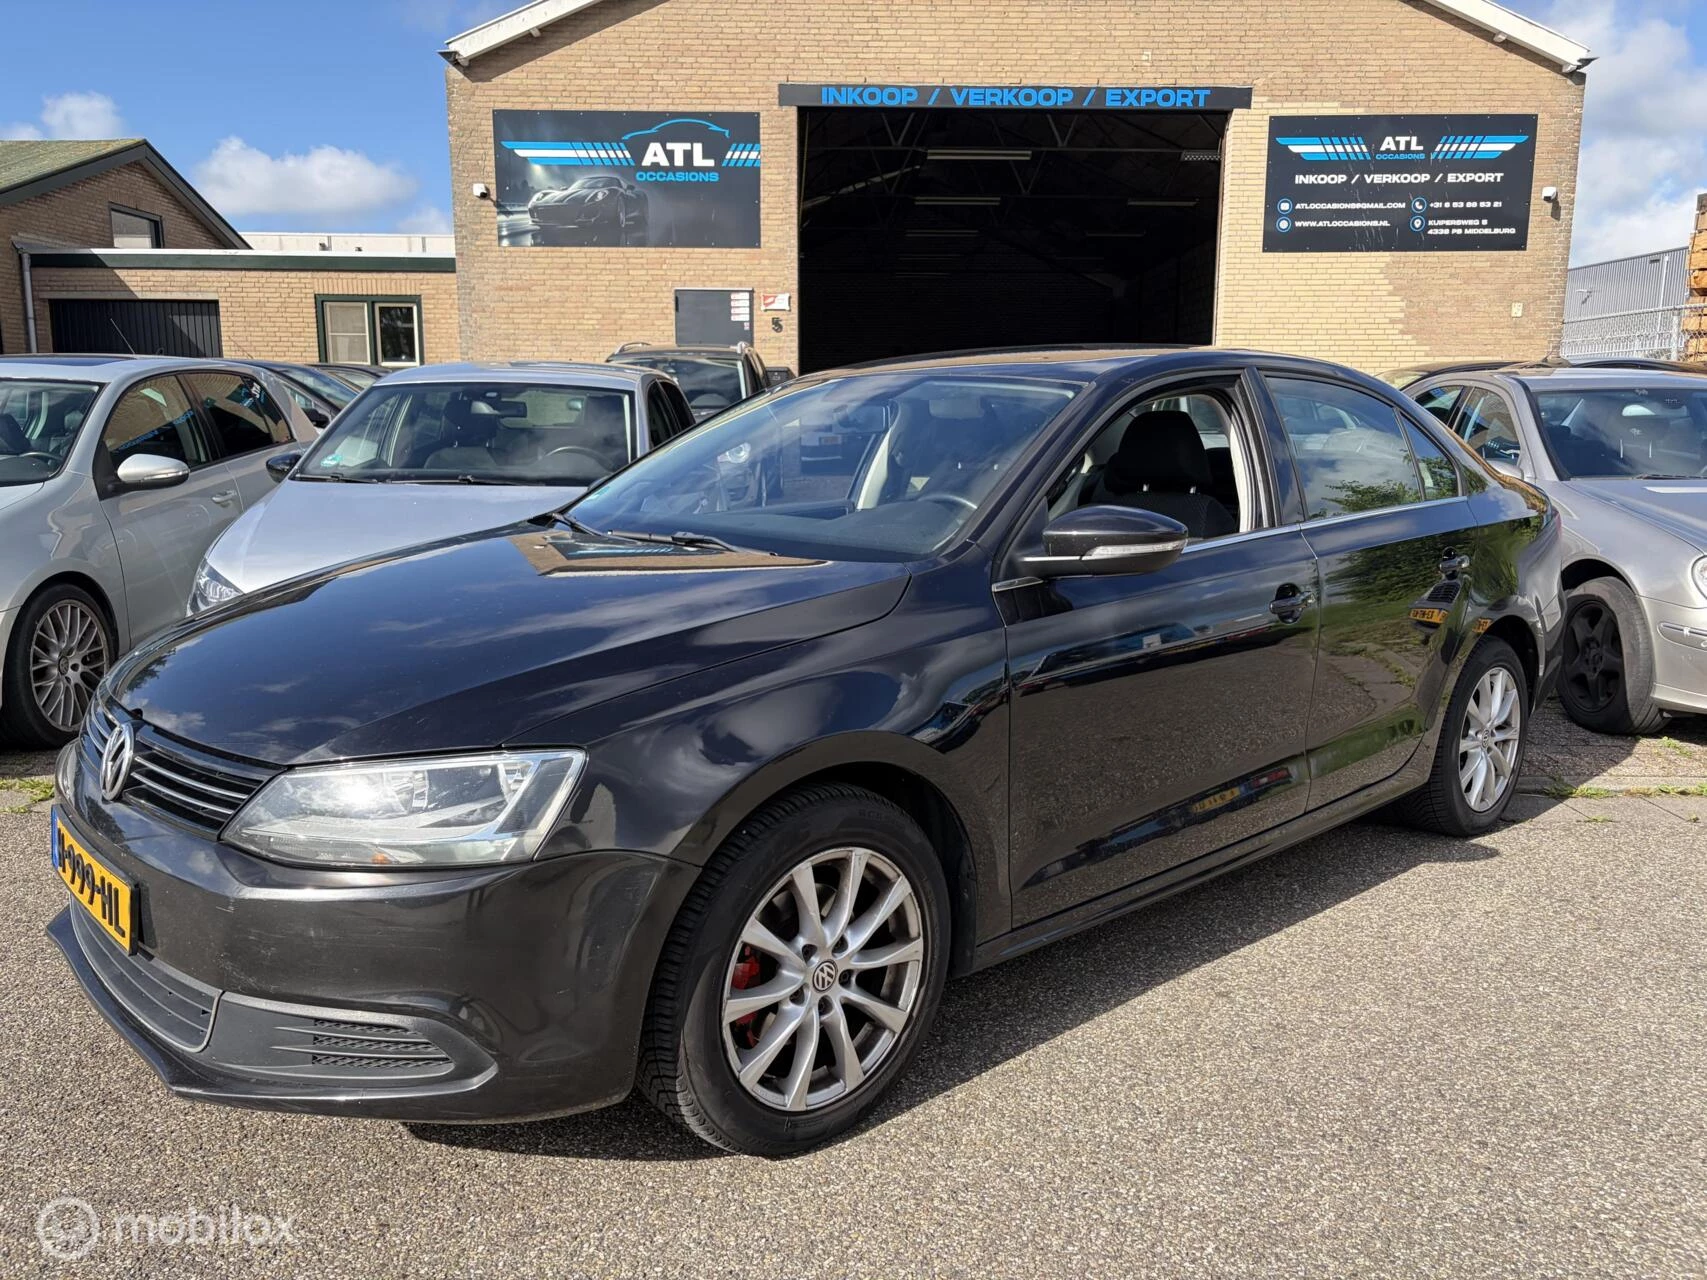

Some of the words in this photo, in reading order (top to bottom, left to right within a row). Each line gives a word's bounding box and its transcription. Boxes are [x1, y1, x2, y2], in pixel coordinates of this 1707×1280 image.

[821, 86, 918, 105] INKOOP
[927, 88, 941, 105] /
[950, 88, 1075, 106] VERKOOP
[1083, 89, 1096, 106] /
[1105, 89, 1211, 108] EXPORT
[1379, 136, 1424, 151] ATL
[641, 142, 715, 167] ATL
[635, 171, 719, 182] OCCASIONS
[1295, 174, 1347, 185] INKOOP
[1351, 174, 1359, 184] /
[1364, 173, 1431, 184] VERKOOP
[1434, 173, 1443, 183] /
[1447, 172, 1504, 183] EXPORT
[771, 317, 783, 333] 5
